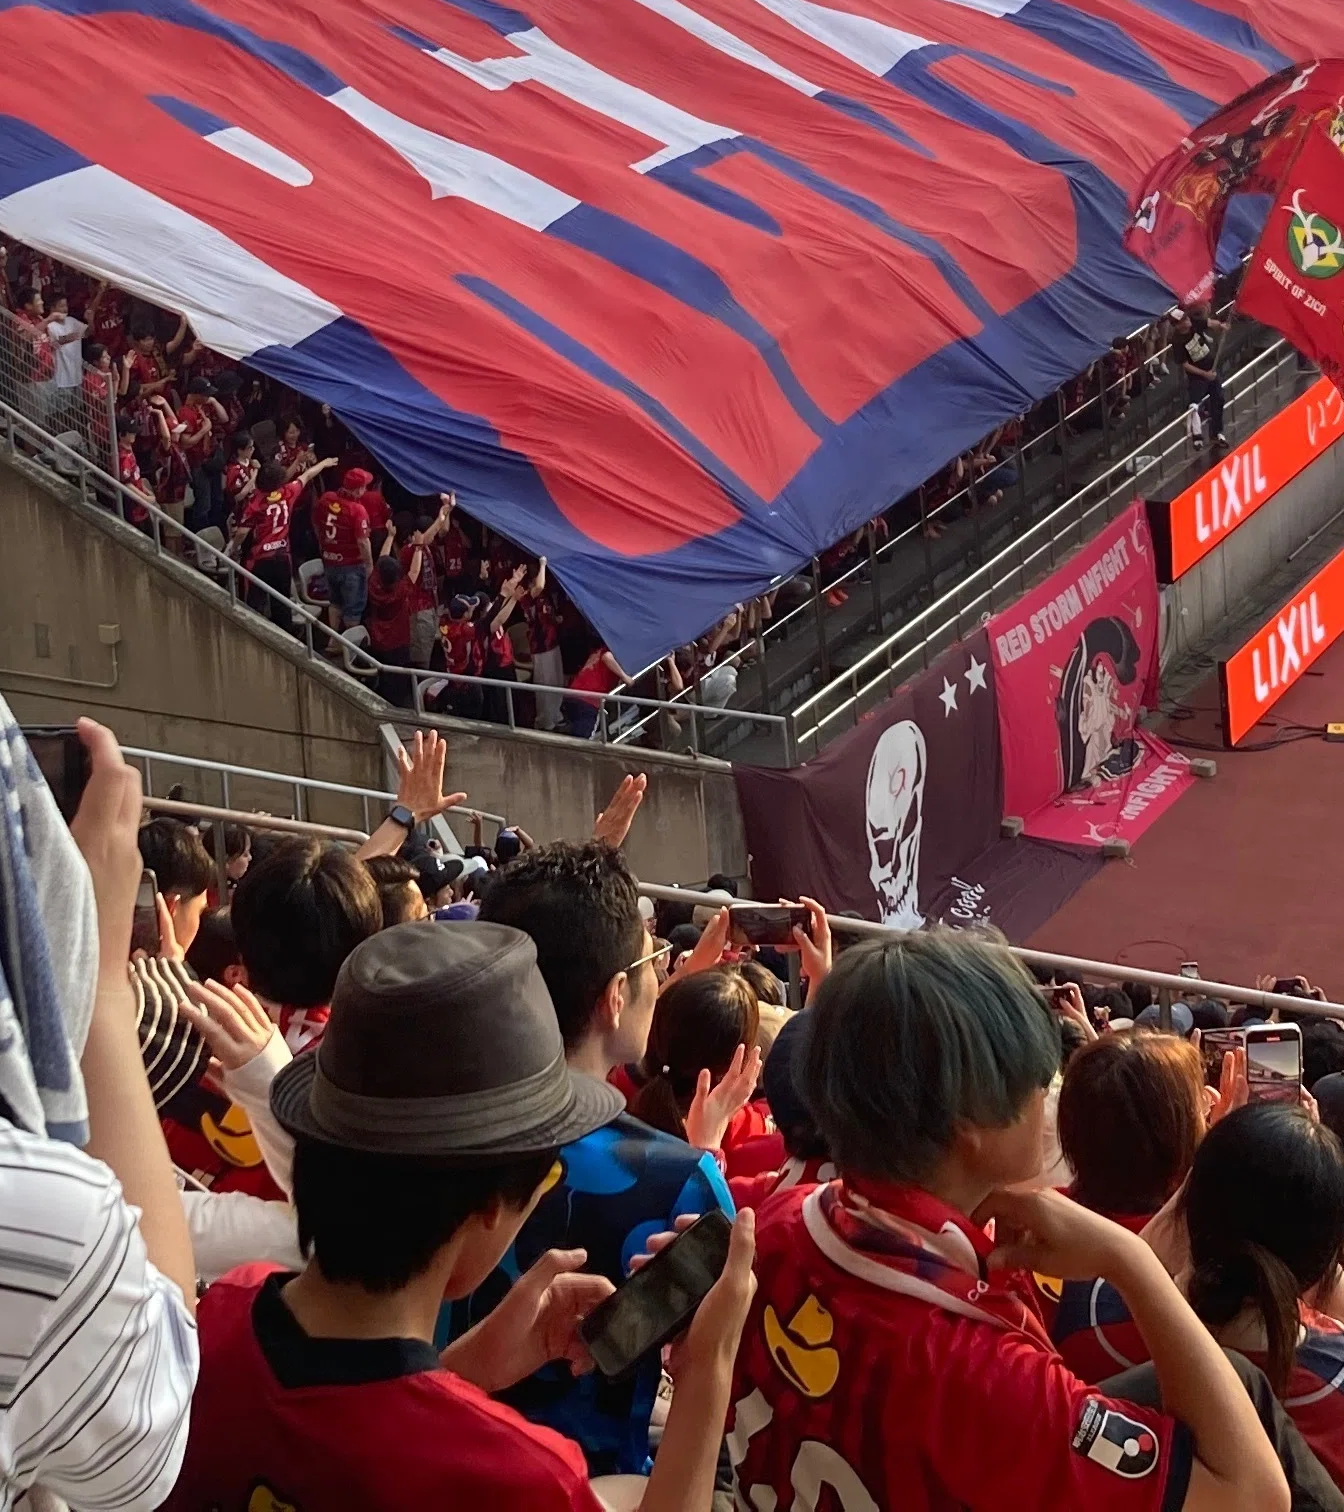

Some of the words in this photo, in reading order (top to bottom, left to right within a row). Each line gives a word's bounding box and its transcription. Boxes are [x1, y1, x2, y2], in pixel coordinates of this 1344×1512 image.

[1263, 258, 1293, 290] SPIRIT
[1291, 284, 1306, 300] OF
[1193, 443, 1268, 544] LIXIL
[995, 625, 1033, 667] RED
[1030, 583, 1085, 651] STORM
[1082, 541, 1130, 613] INFIGHT
[1251, 590, 1326, 704] LIXIL
